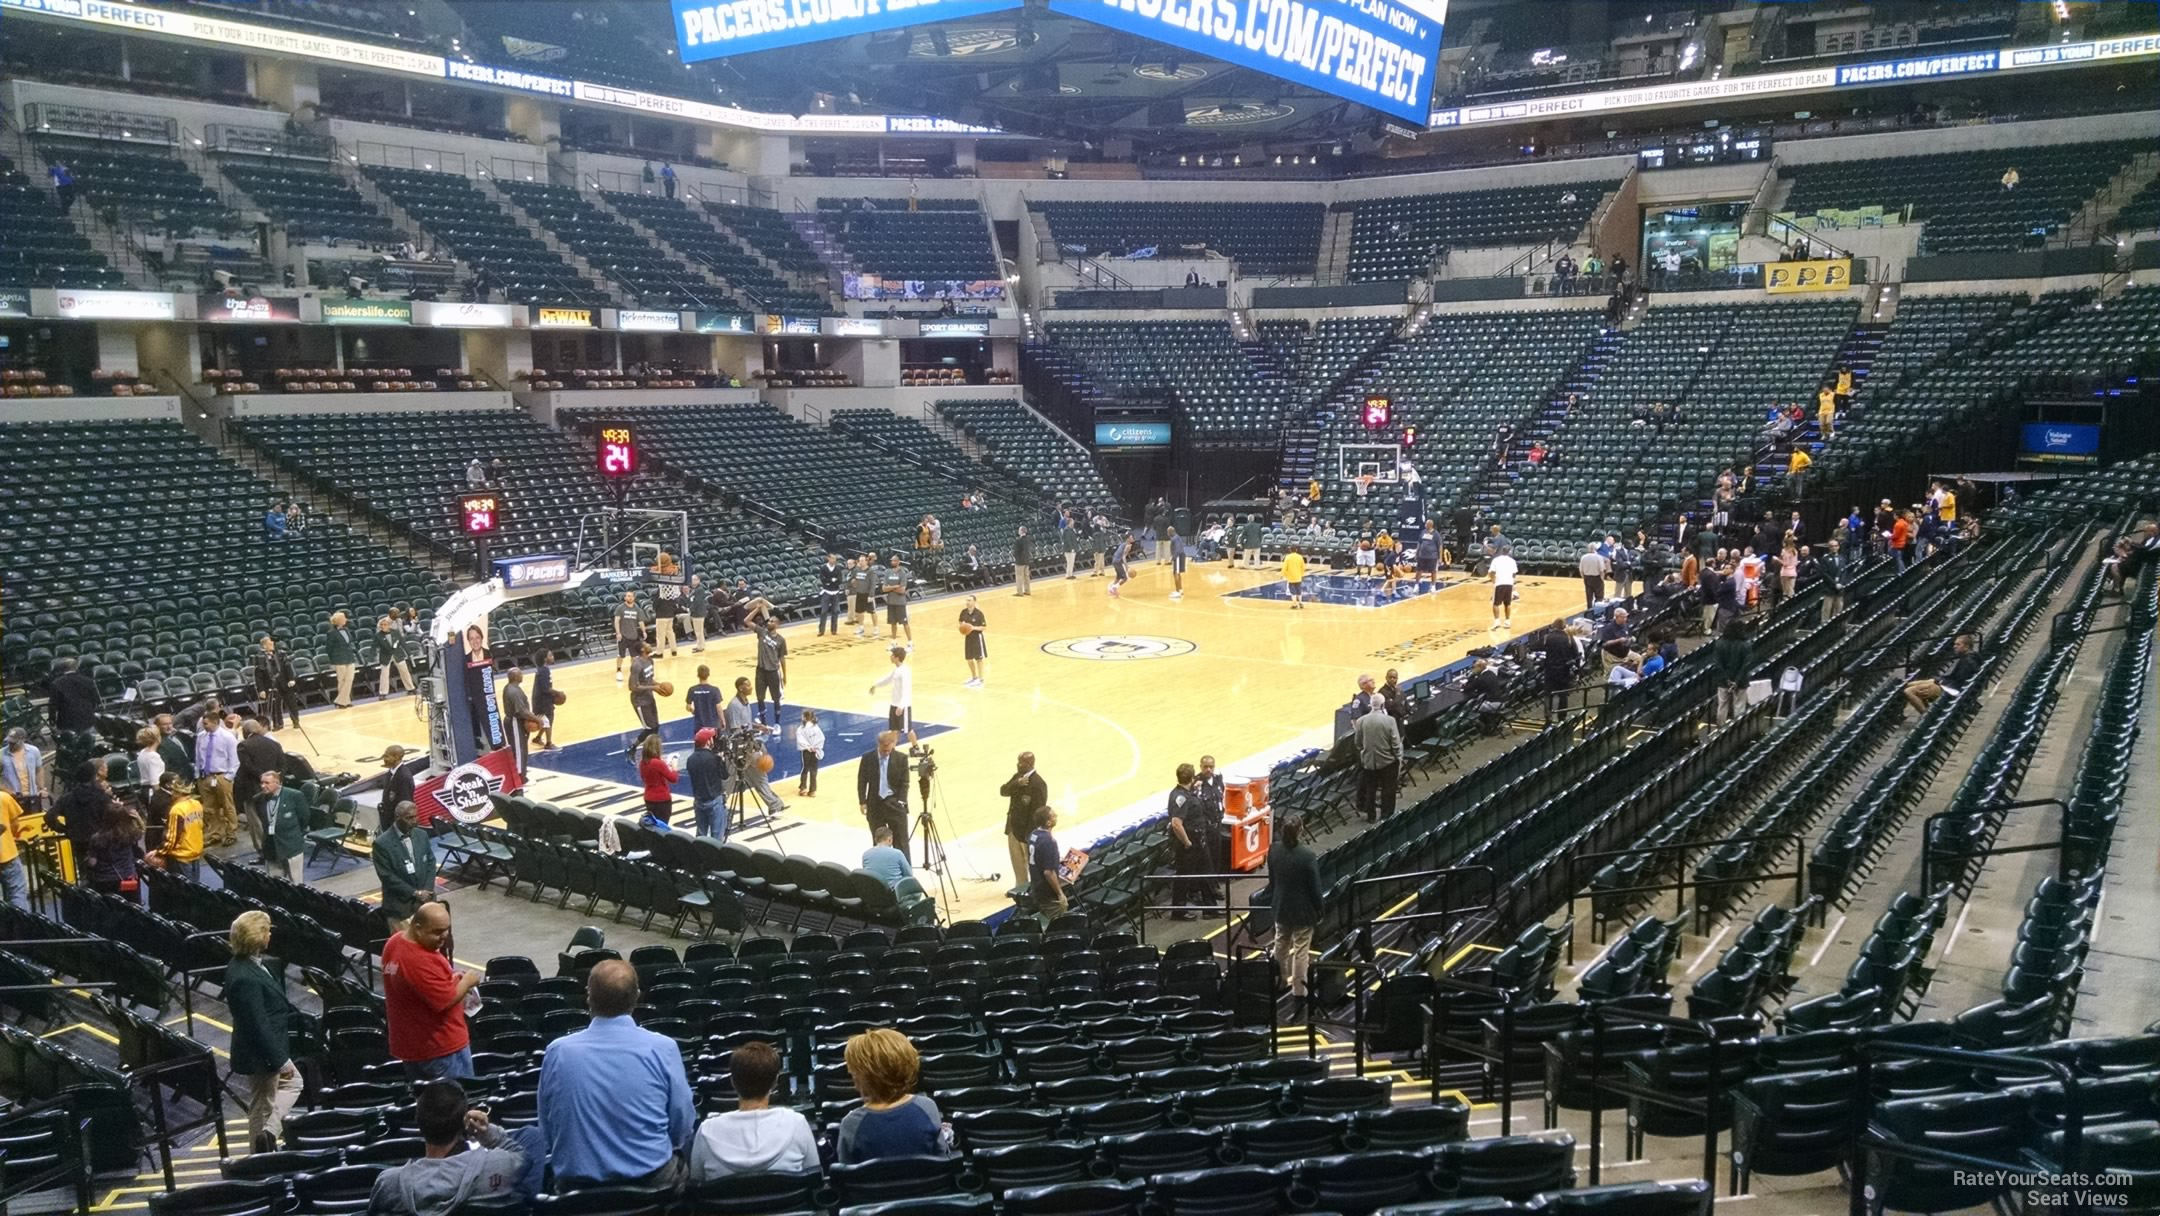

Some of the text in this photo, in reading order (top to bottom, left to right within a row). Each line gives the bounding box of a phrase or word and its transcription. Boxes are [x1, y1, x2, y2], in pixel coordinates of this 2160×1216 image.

[87, 3, 166, 28] PERFECT
[1388, 6, 1418, 36] NOW
[193, 21, 216, 35] PICK
[218, 26, 242, 39] YOUR
[257, 32, 299, 49] FAVORITE
[302, 39, 331, 54] GAMES
[335, 45, 350, 57] FOR
[371, 51, 405, 66] PERFECT
[1841, 53, 1996, 84] PACERS.COM/PERFECT
[449, 61, 573, 97] PACERS.COM/PERFECT
[1604, 74, 1828, 106] PICK YOUR 10 FAVORITE GAMES FOR THE PERFECT 10 PLAN
[639, 95, 684, 111] PERFECT
[1529, 99, 1584, 114] PERFECT
[820, 119, 849, 128] PERFECT
[226, 298, 246, 309] the
[323, 305, 410, 318] bankerslife.com
[621, 312, 678, 325] ticketmaster
[920, 323, 988, 332] SPORT GRAPHICS
[1367, 408, 1386, 423] 24
[602, 429, 630, 443] 49:39
[606, 445, 629, 471] 24
[464, 498, 495, 511] 49:39
[471, 512, 489, 530] 24
[525, 564, 566, 580] Pacers
[600, 569, 643, 579] BANKERS LIFE
[488, 711, 502, 745] Honda
[454, 777, 484, 793] Steak
[457, 794, 488, 810] Shake
